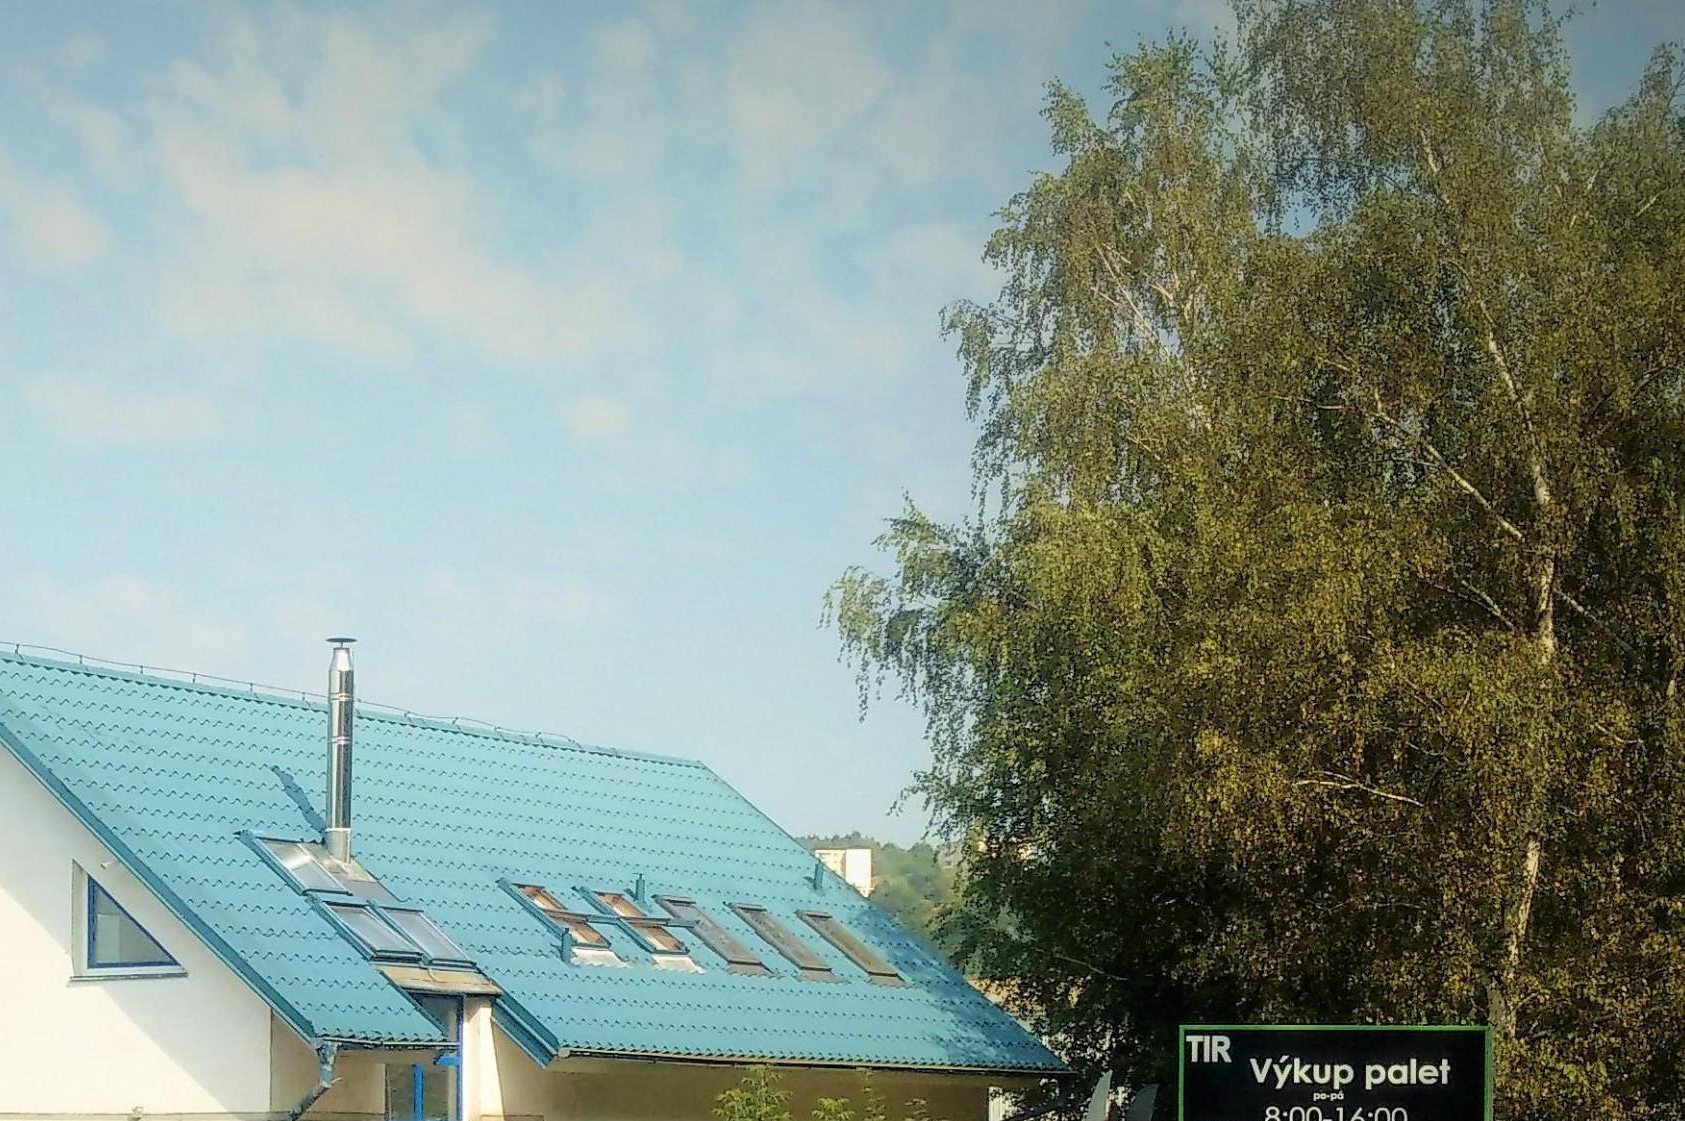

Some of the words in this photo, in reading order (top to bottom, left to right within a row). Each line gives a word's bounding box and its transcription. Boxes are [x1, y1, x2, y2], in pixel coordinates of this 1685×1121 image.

[1186, 1035, 1232, 1063] TIR
[1249, 1055, 1354, 1089] Výkup
[1365, 1058, 1451, 1090] palet
